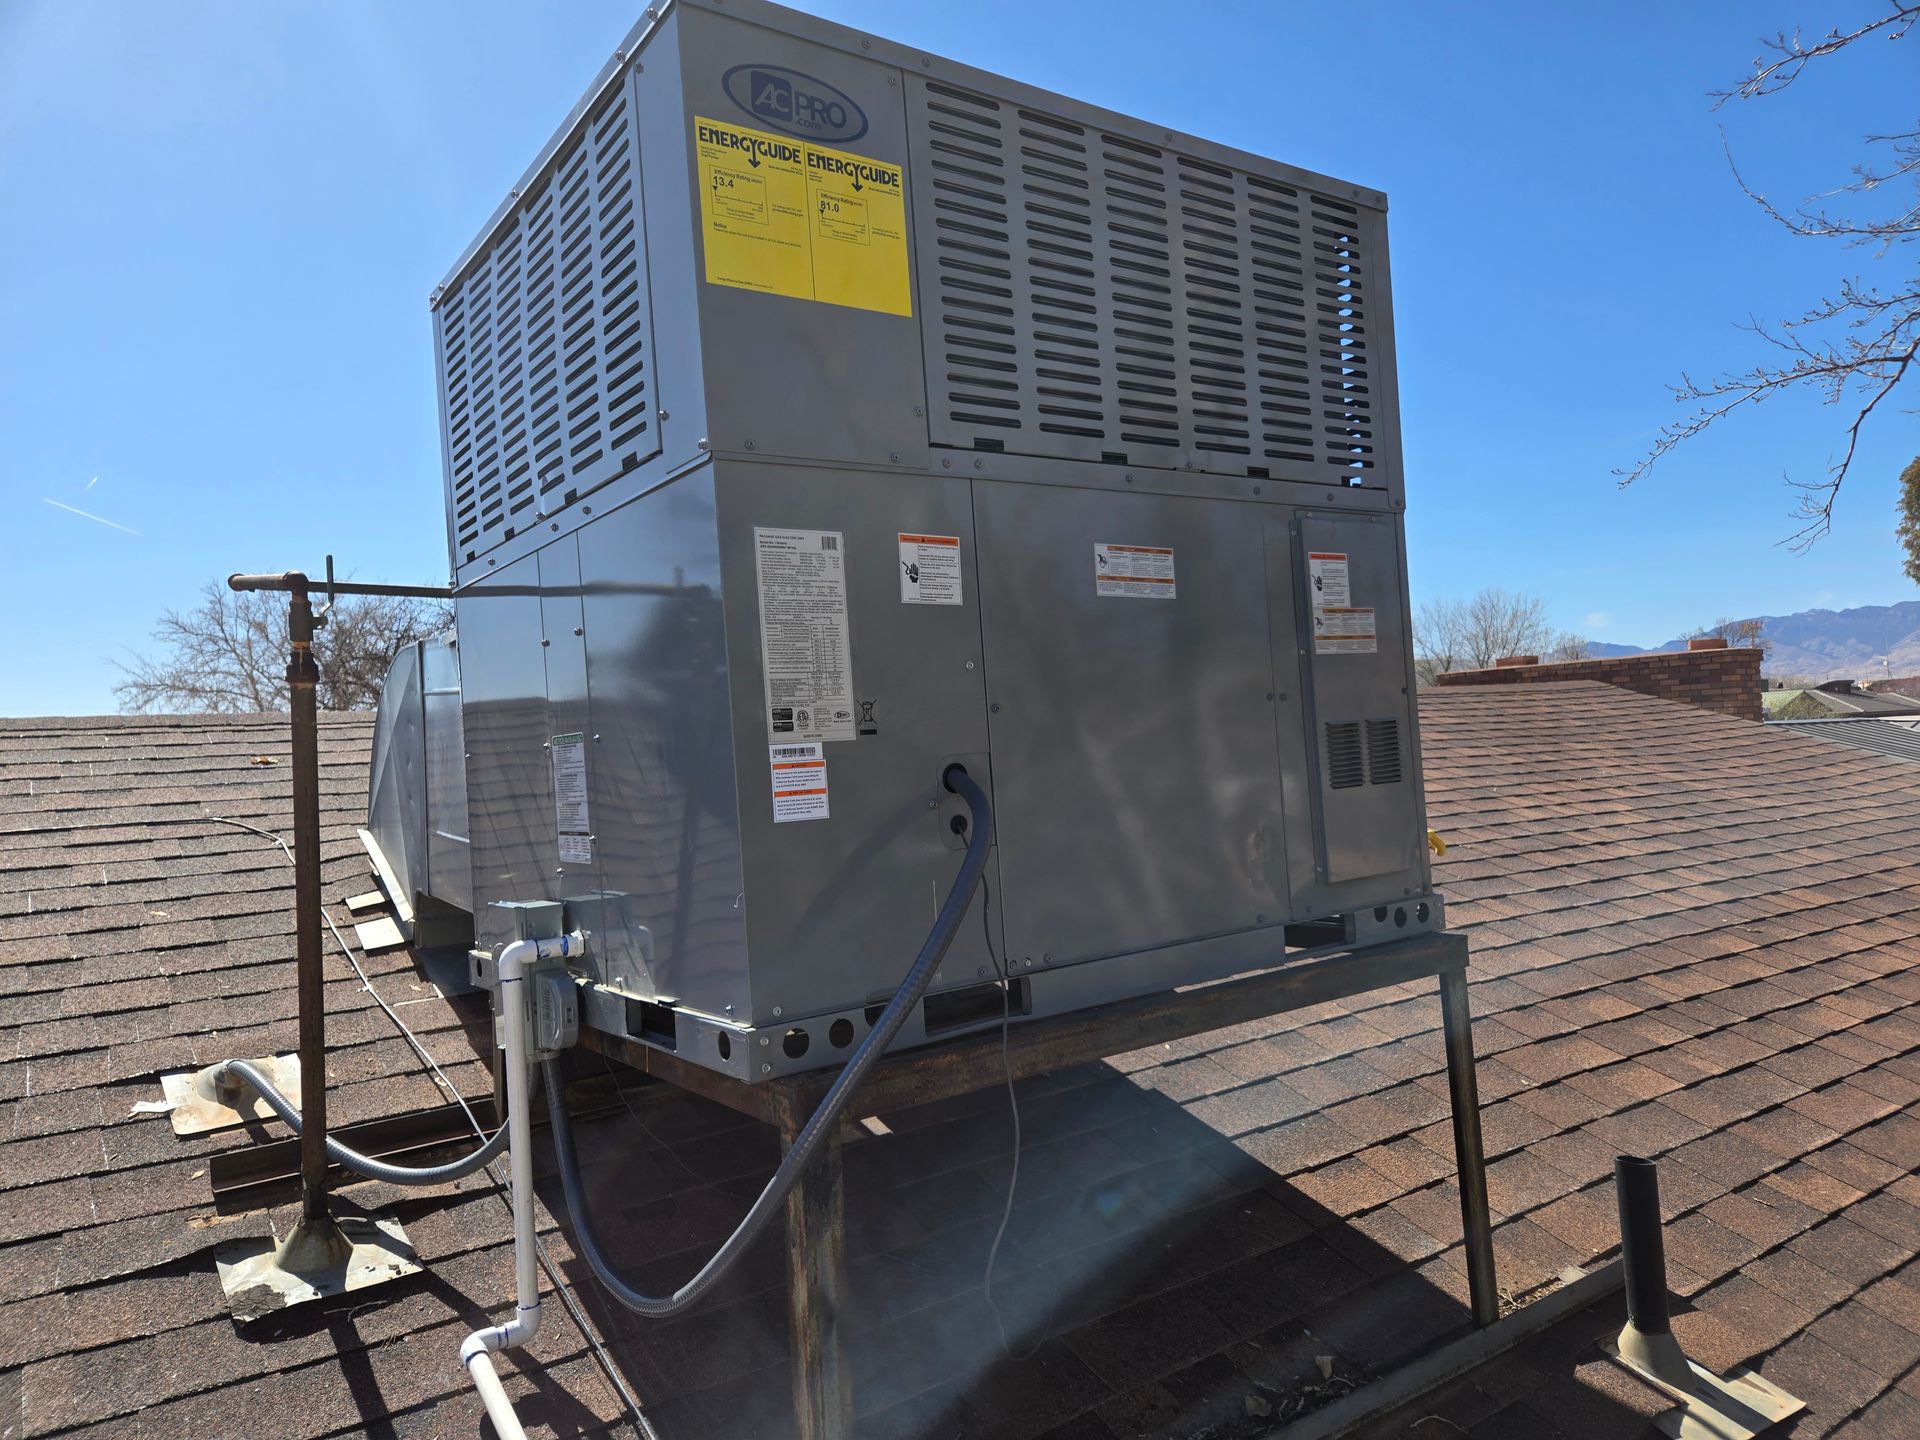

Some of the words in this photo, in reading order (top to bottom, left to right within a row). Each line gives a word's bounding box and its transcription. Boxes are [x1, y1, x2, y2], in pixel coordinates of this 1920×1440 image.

[755, 83, 789, 113] AC
[794, 91, 847, 128] PRO
[699, 126, 802, 166] ENERGYGUIDE
[714, 168, 735, 180] Efficiency
[807, 153, 900, 189] ENERGYGUIDE
[713, 176, 735, 188] 13.4
[820, 193, 840, 203] Efficiency
[820, 200, 840, 213] 81.0
